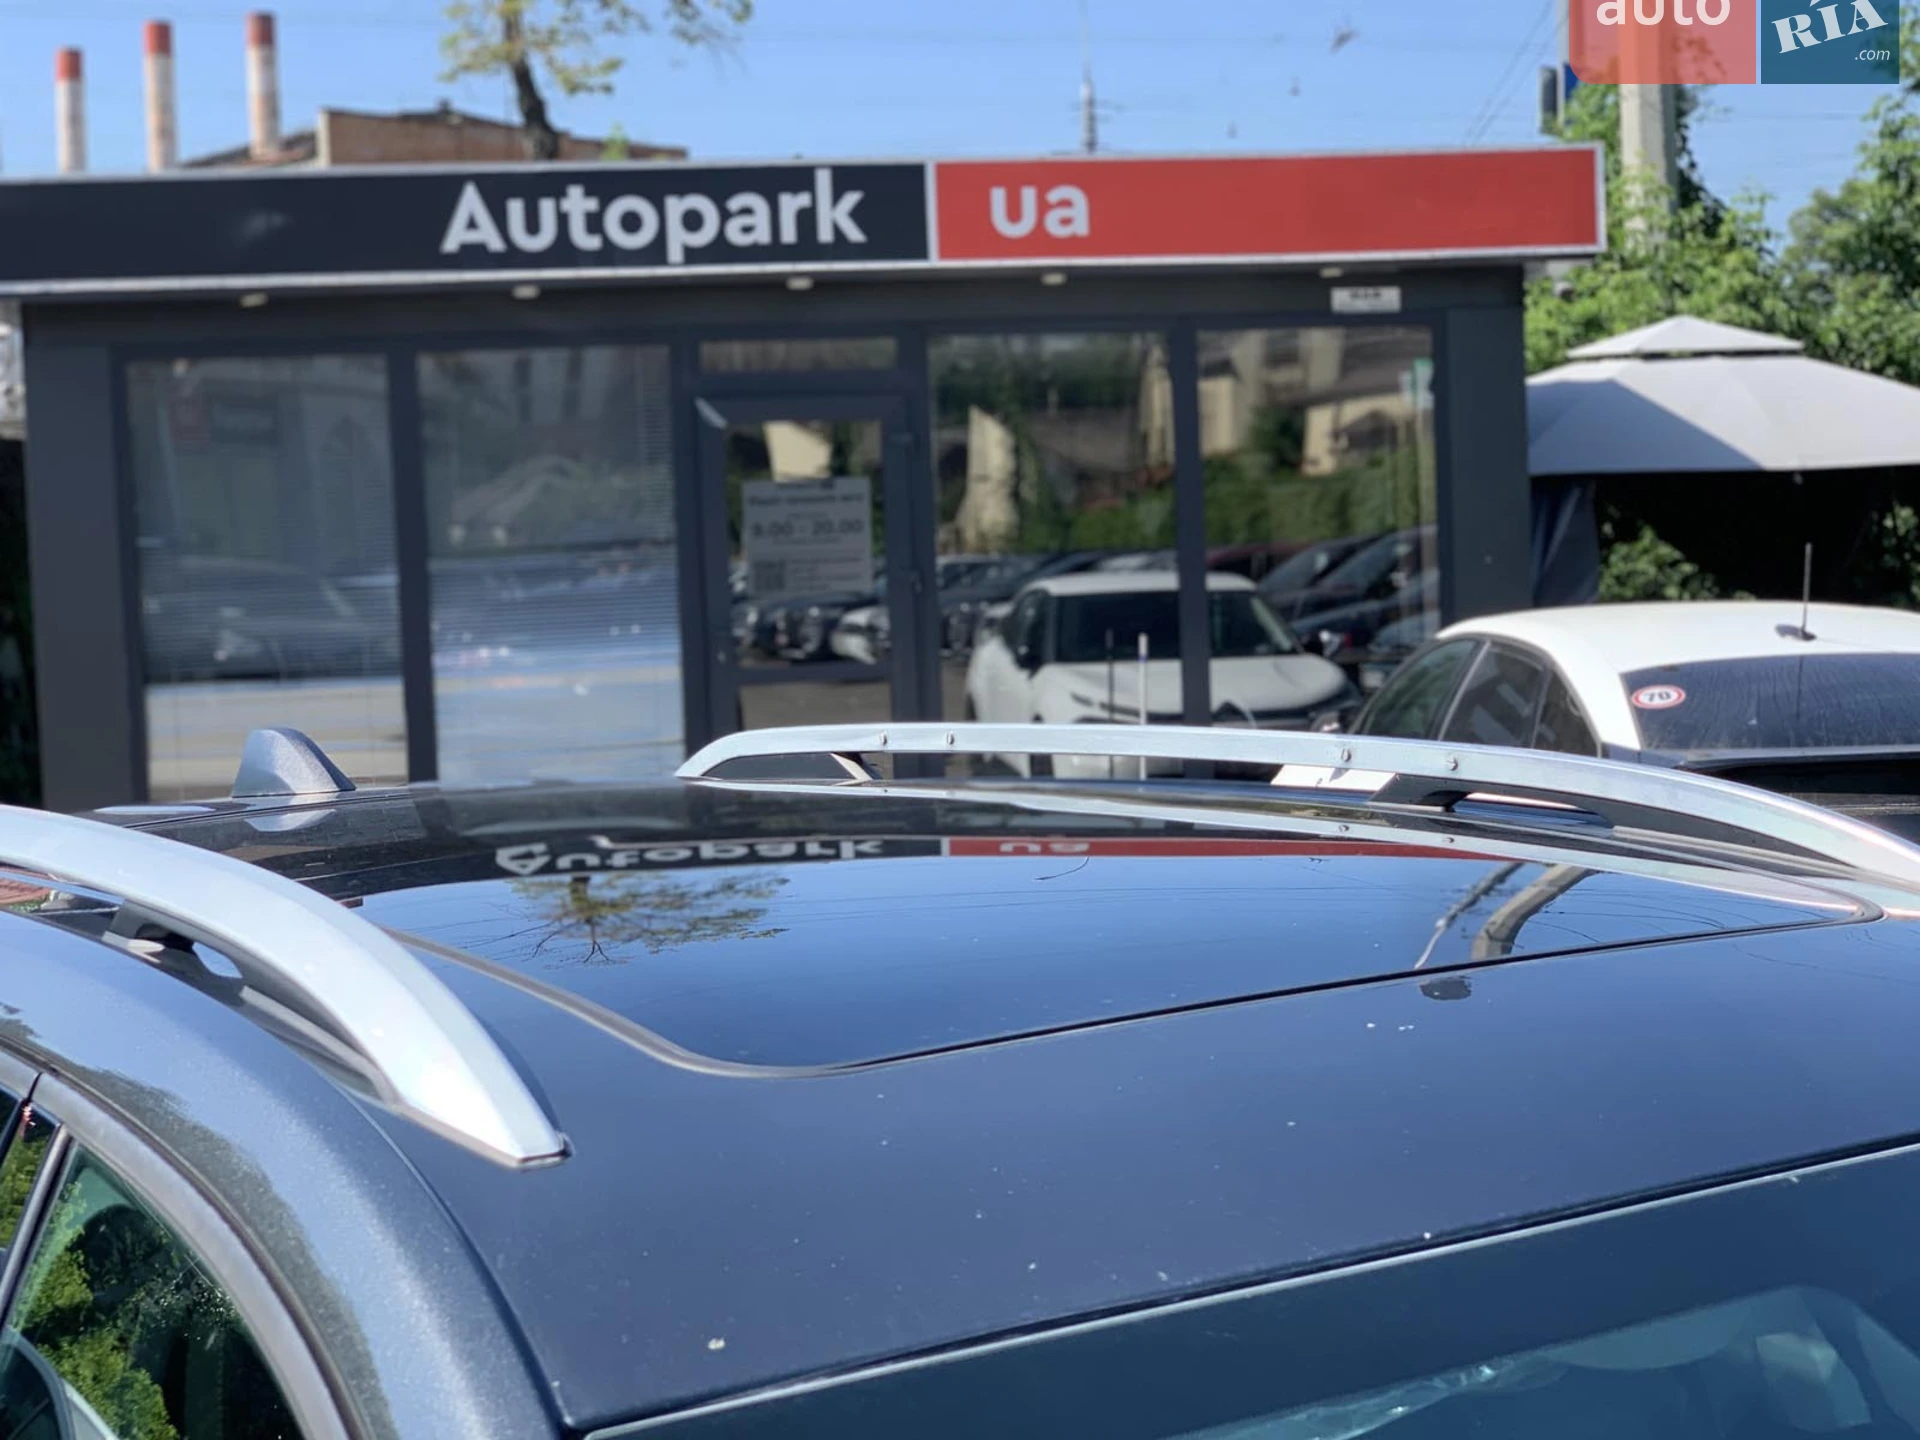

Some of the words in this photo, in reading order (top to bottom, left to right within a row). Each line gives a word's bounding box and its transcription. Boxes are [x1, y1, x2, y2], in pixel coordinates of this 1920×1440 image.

[440, 167, 867, 265] Autopark
[989, 183, 1091, 239] ua
[1644, 691, 1671, 702] 70
